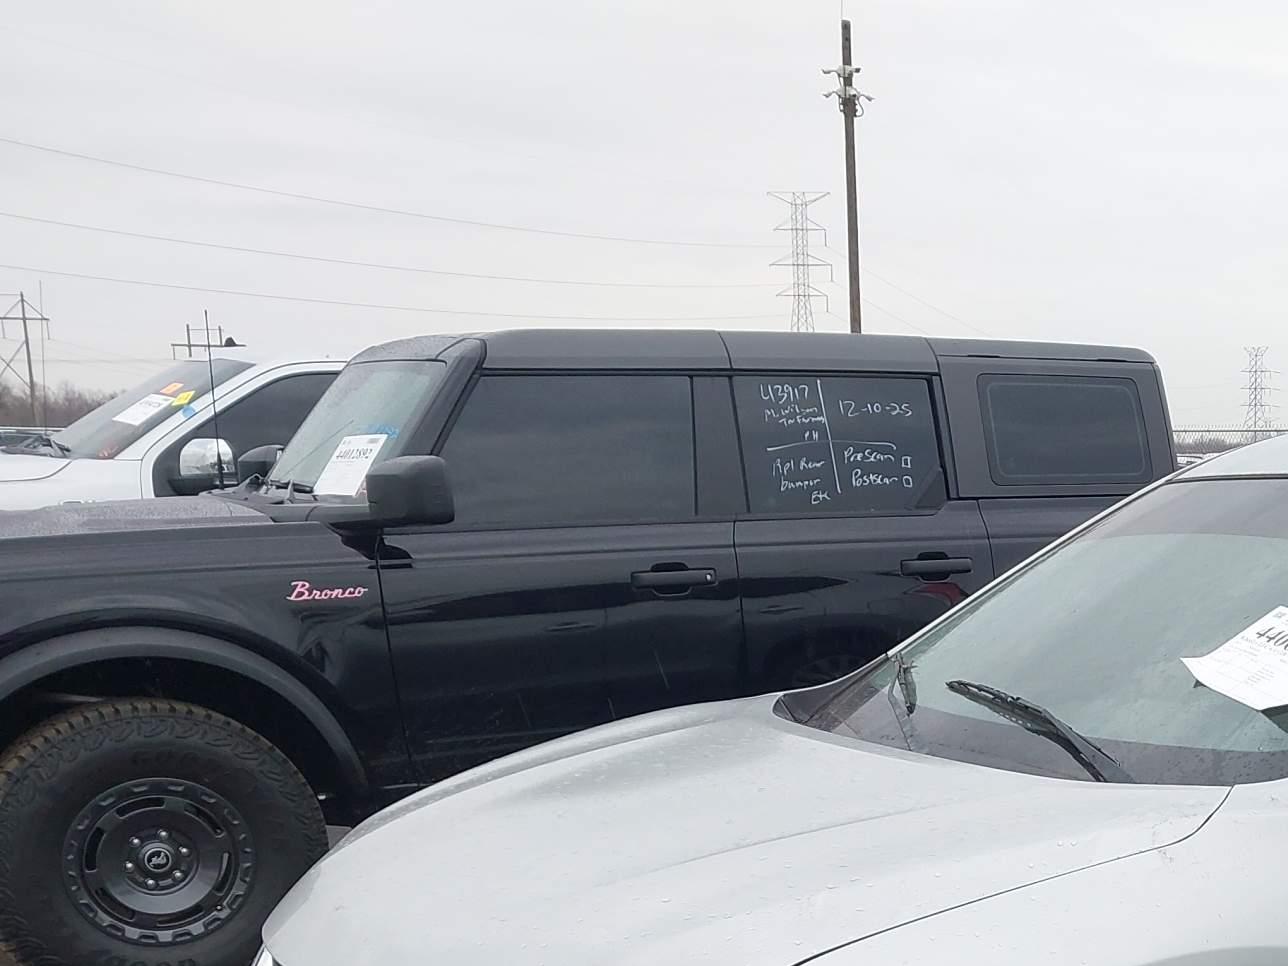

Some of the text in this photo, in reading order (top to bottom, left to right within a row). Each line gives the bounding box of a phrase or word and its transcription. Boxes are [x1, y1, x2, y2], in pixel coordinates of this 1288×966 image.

[760, 383, 808, 404] 43917
[839, 399, 912, 417] 12-10-25
[285, 580, 369, 601] Bronco
